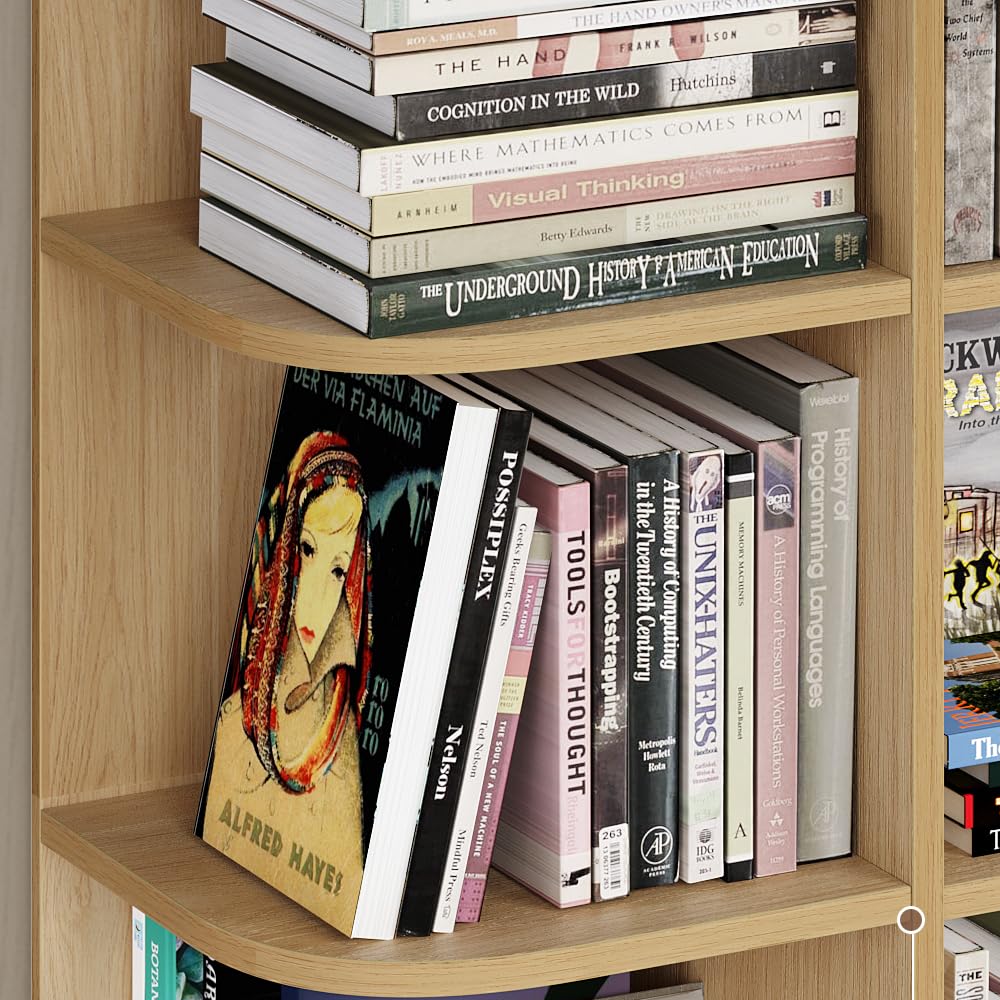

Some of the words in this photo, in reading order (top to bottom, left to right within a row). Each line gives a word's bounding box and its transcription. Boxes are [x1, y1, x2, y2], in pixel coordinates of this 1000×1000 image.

[435, 58, 482, 75] THE
[498, 48, 567, 68] HAND
[670, 71, 736, 92] Hutchins
[427, 97, 526, 122] COGNITION
[530, 93, 551, 110] IN
[554, 88, 591, 107] THE
[593, 82, 640, 100] WILD
[411, 147, 484, 168] WHERE
[496, 128, 654, 158] MATHEMATICS
[664, 115, 735, 137] COMES
[746, 108, 803, 127] FROM
[397, 203, 458, 219] ARNHEIM
[488, 186, 567, 209] Visual
[577, 171, 686, 197] Thinking
[540, 230, 566, 242] Betty
[569, 224, 613, 238] Edwards
[474, 451, 518, 601] POSSIPLEX
[694, 513, 718, 525] THE
[567, 531, 586, 616] TOOLS
[602, 568, 621, 732] Bootstrapping
[694, 526, 718, 749] UNIX-HATERS
[567, 666, 586, 795] THOUGHT
[434, 724, 464, 800] Nelson
[218, 800, 283, 857] ALFRED
[288, 841, 344, 896] HAYES
[602, 829, 622, 840] 263
